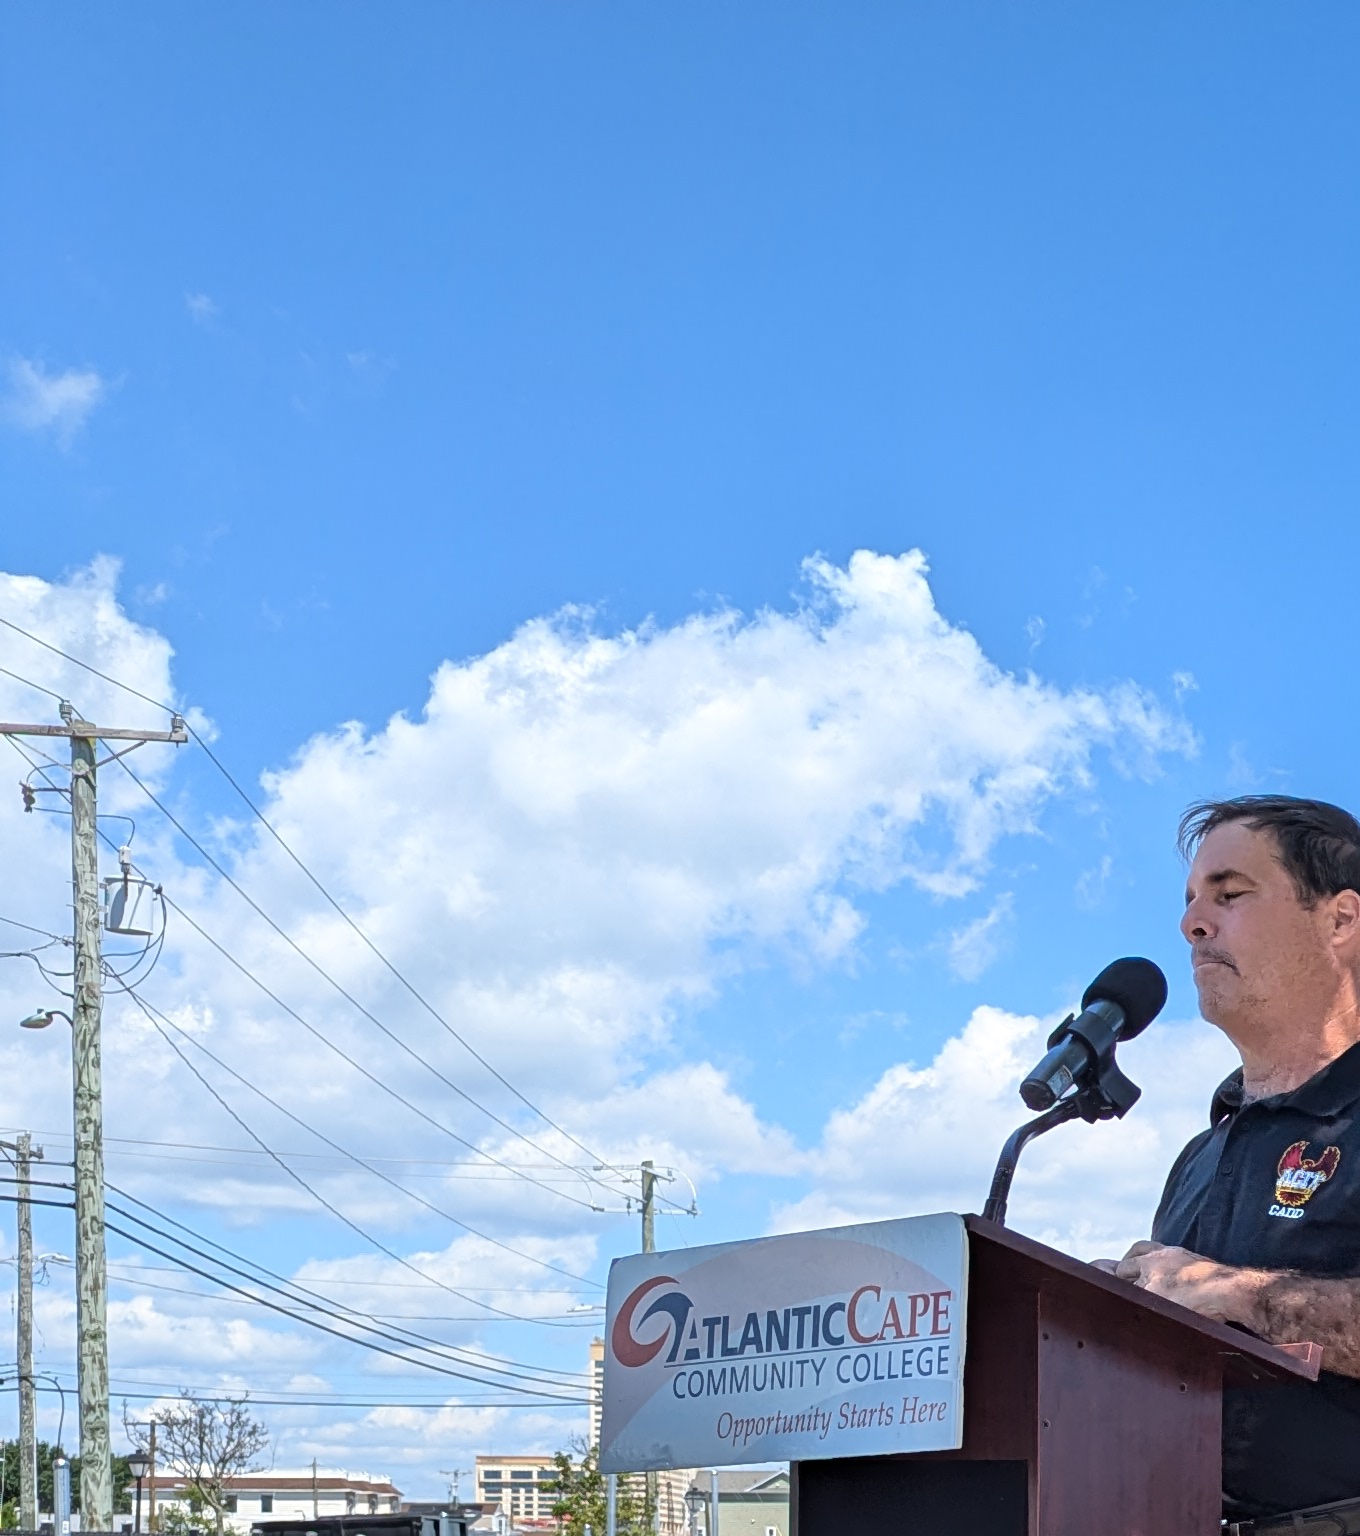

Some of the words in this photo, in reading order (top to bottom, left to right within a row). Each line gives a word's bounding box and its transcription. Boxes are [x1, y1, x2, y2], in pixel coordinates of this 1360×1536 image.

[1268, 1204, 1304, 1218] CADD
[673, 1357, 827, 1399] COMMUNITY
[836, 1345, 950, 1384] COLLEGE
[716, 1405, 832, 1446] Opportunity
[837, 1401, 894, 1430] Starts
[899, 1396, 948, 1424] Here
